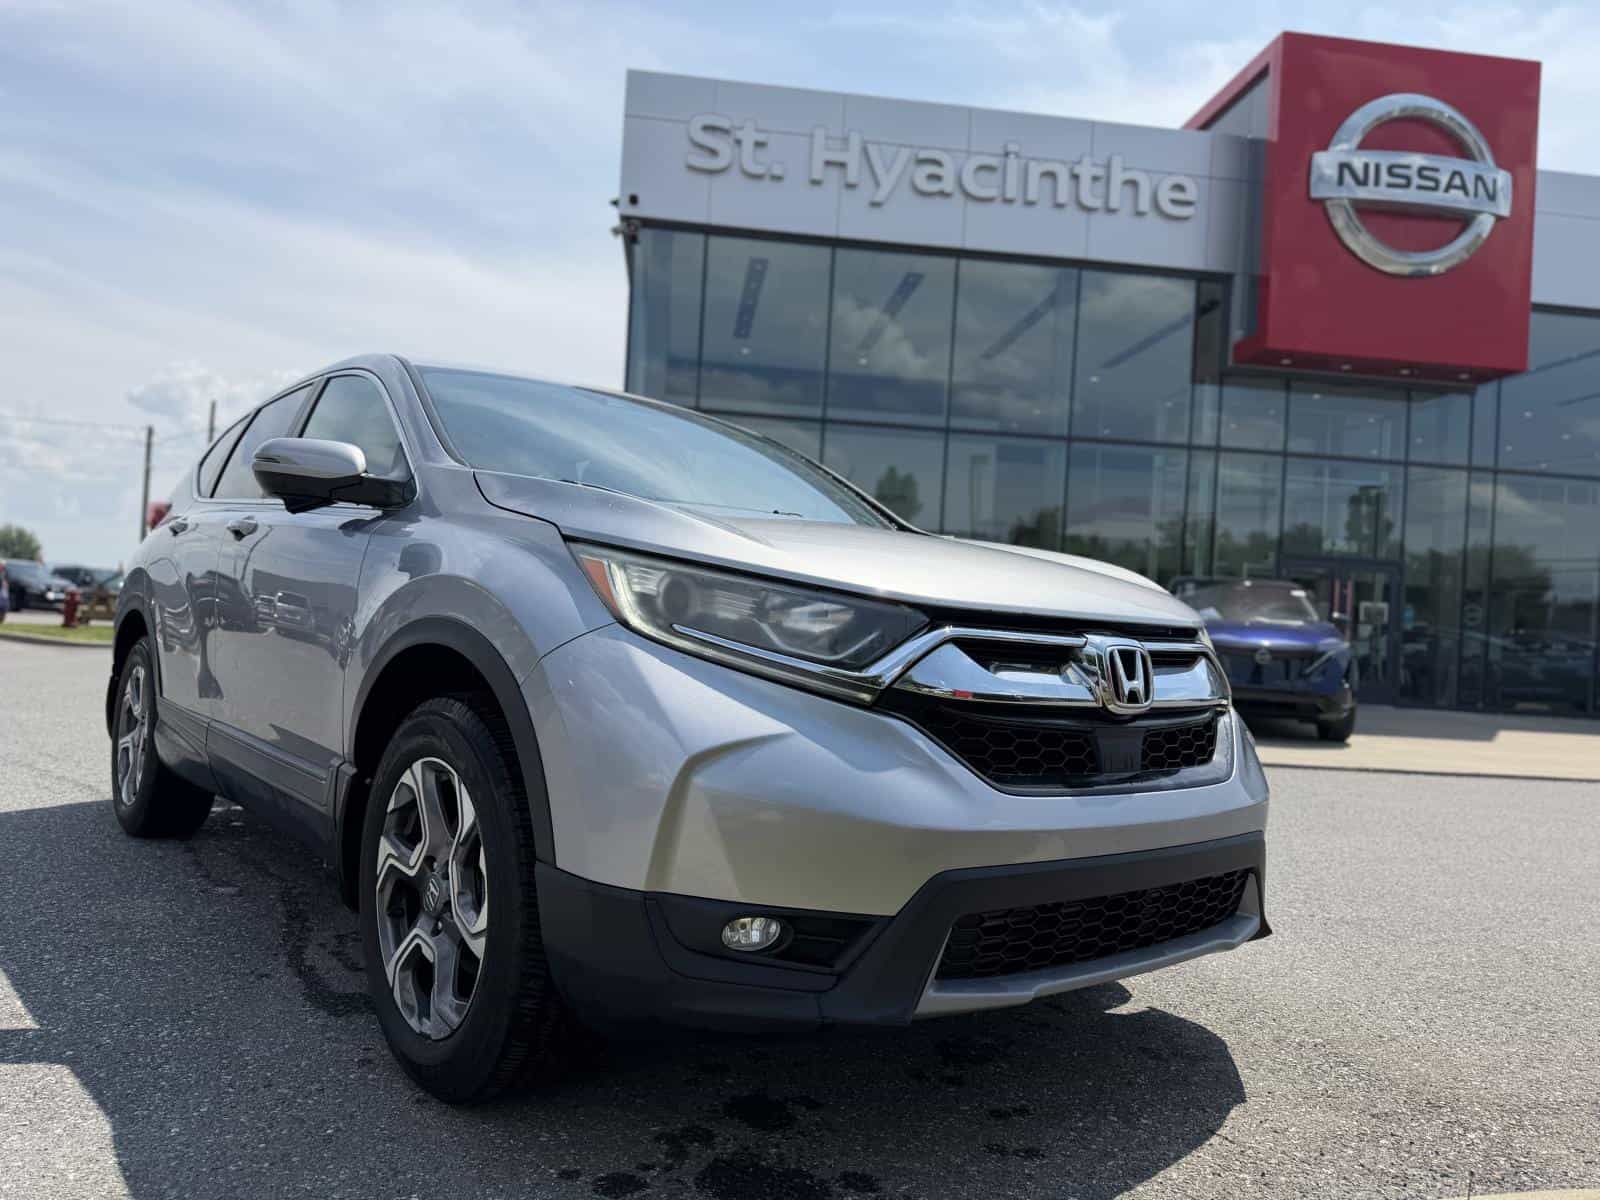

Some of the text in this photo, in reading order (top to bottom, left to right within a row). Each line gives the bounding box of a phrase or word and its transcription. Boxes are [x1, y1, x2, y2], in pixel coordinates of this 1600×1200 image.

[685, 114, 1197, 220] St. Hyacinthe
[1336, 161, 1498, 202] NISSAN
